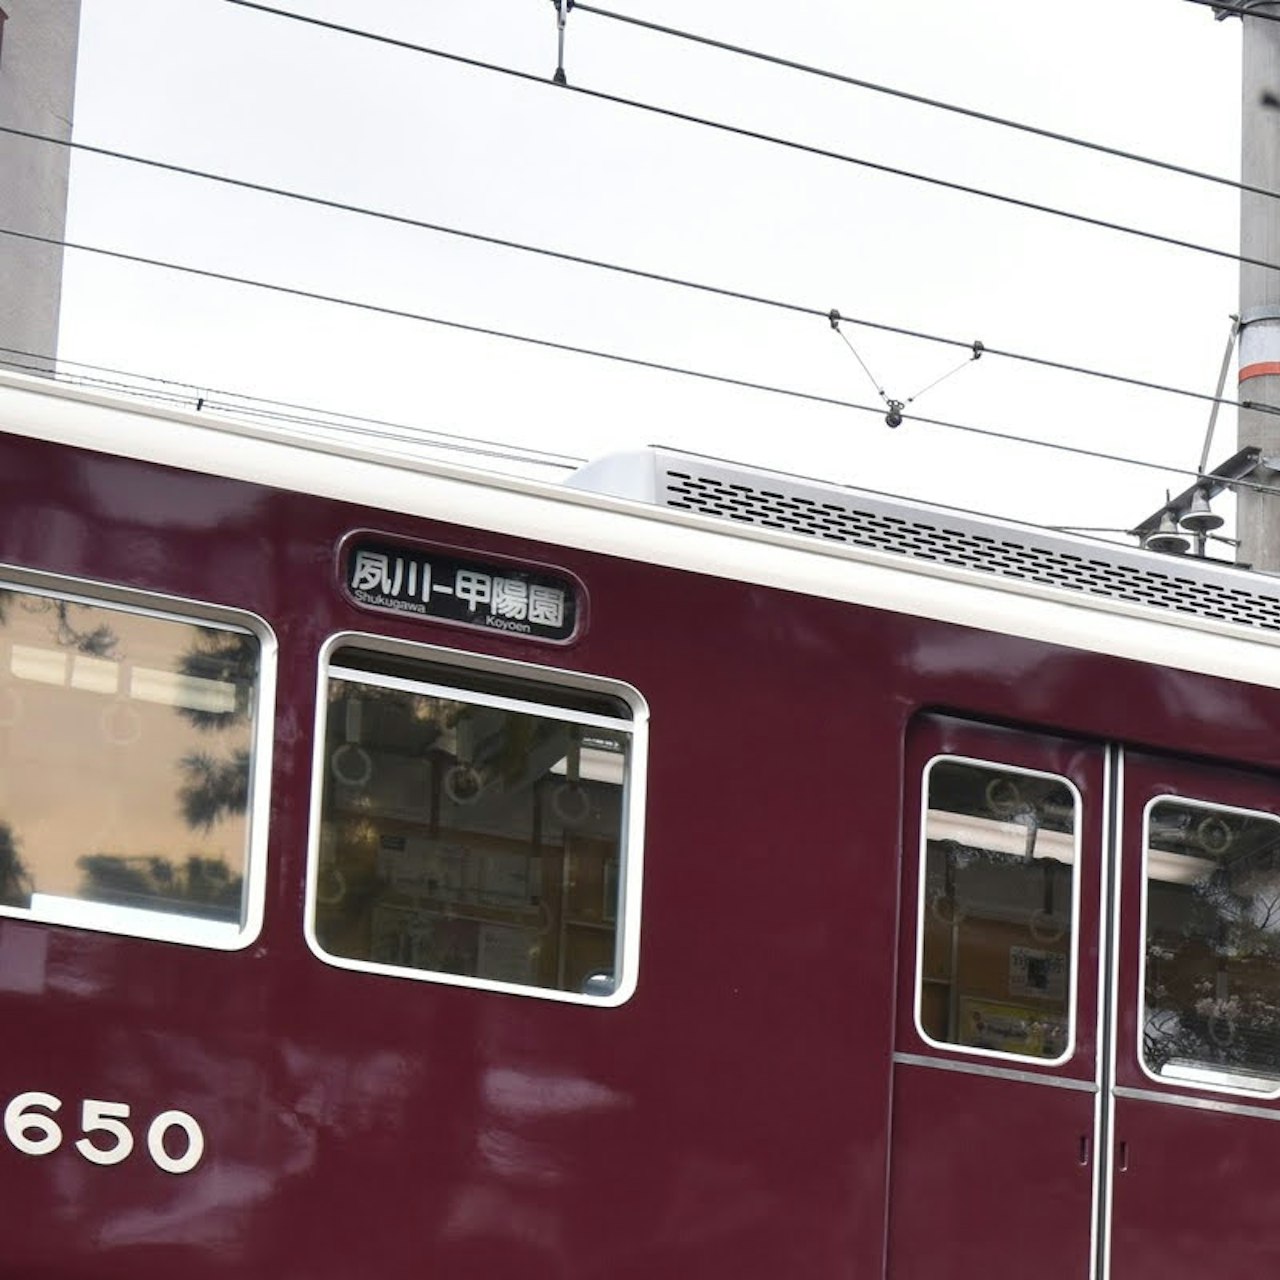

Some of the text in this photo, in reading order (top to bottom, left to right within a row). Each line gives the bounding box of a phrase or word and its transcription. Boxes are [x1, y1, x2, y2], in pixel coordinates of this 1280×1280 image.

[353, 590, 427, 614] Shukugawa
[485, 614, 532, 634] Koyoen
[3, 1091, 205, 1174] 650
